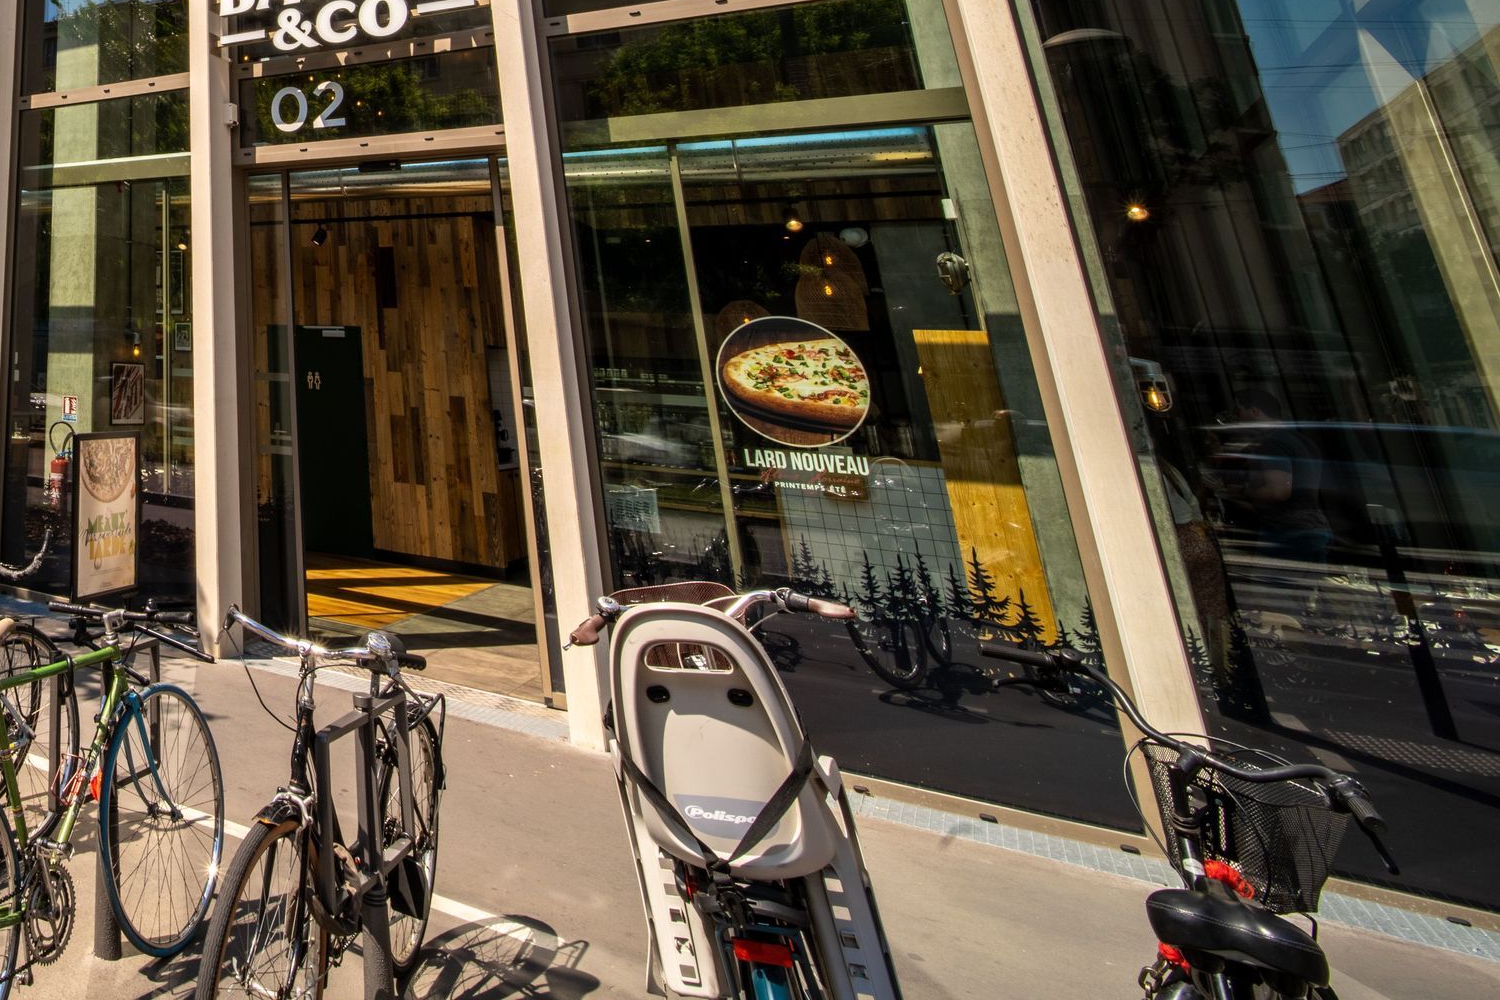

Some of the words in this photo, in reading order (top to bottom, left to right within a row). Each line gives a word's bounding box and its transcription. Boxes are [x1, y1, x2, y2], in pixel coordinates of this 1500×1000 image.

[271, 81, 346, 132] 02
[744, 448, 787, 469] LARD
[790, 451, 870, 476] NOUVEAU
[774, 481, 826, 492] PRINTEMPS
[685, 805, 757, 824] Polispo
